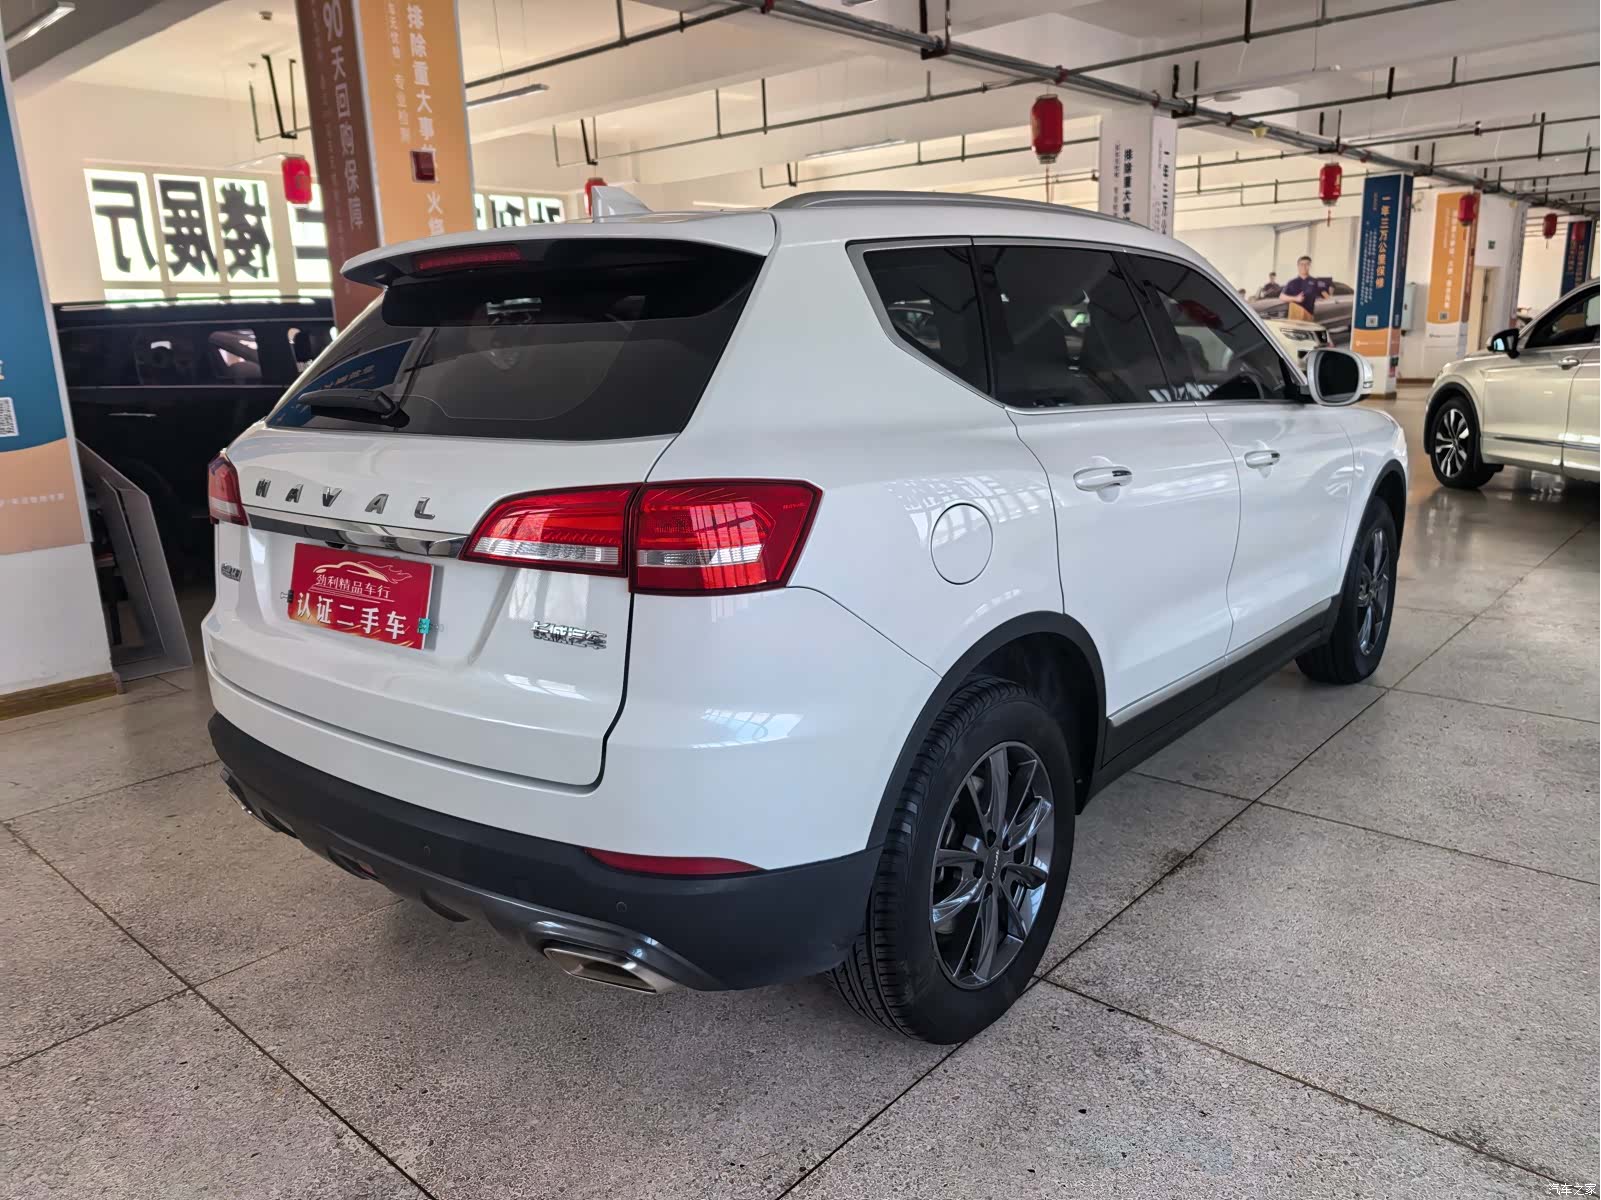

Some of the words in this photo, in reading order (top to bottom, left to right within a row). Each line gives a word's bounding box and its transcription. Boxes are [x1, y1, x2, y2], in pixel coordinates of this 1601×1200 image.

[255, 478, 436, 521] HAVAL
[315, 573, 391, 599] 劲利精品车行
[297, 591, 408, 640] 认证二手车
